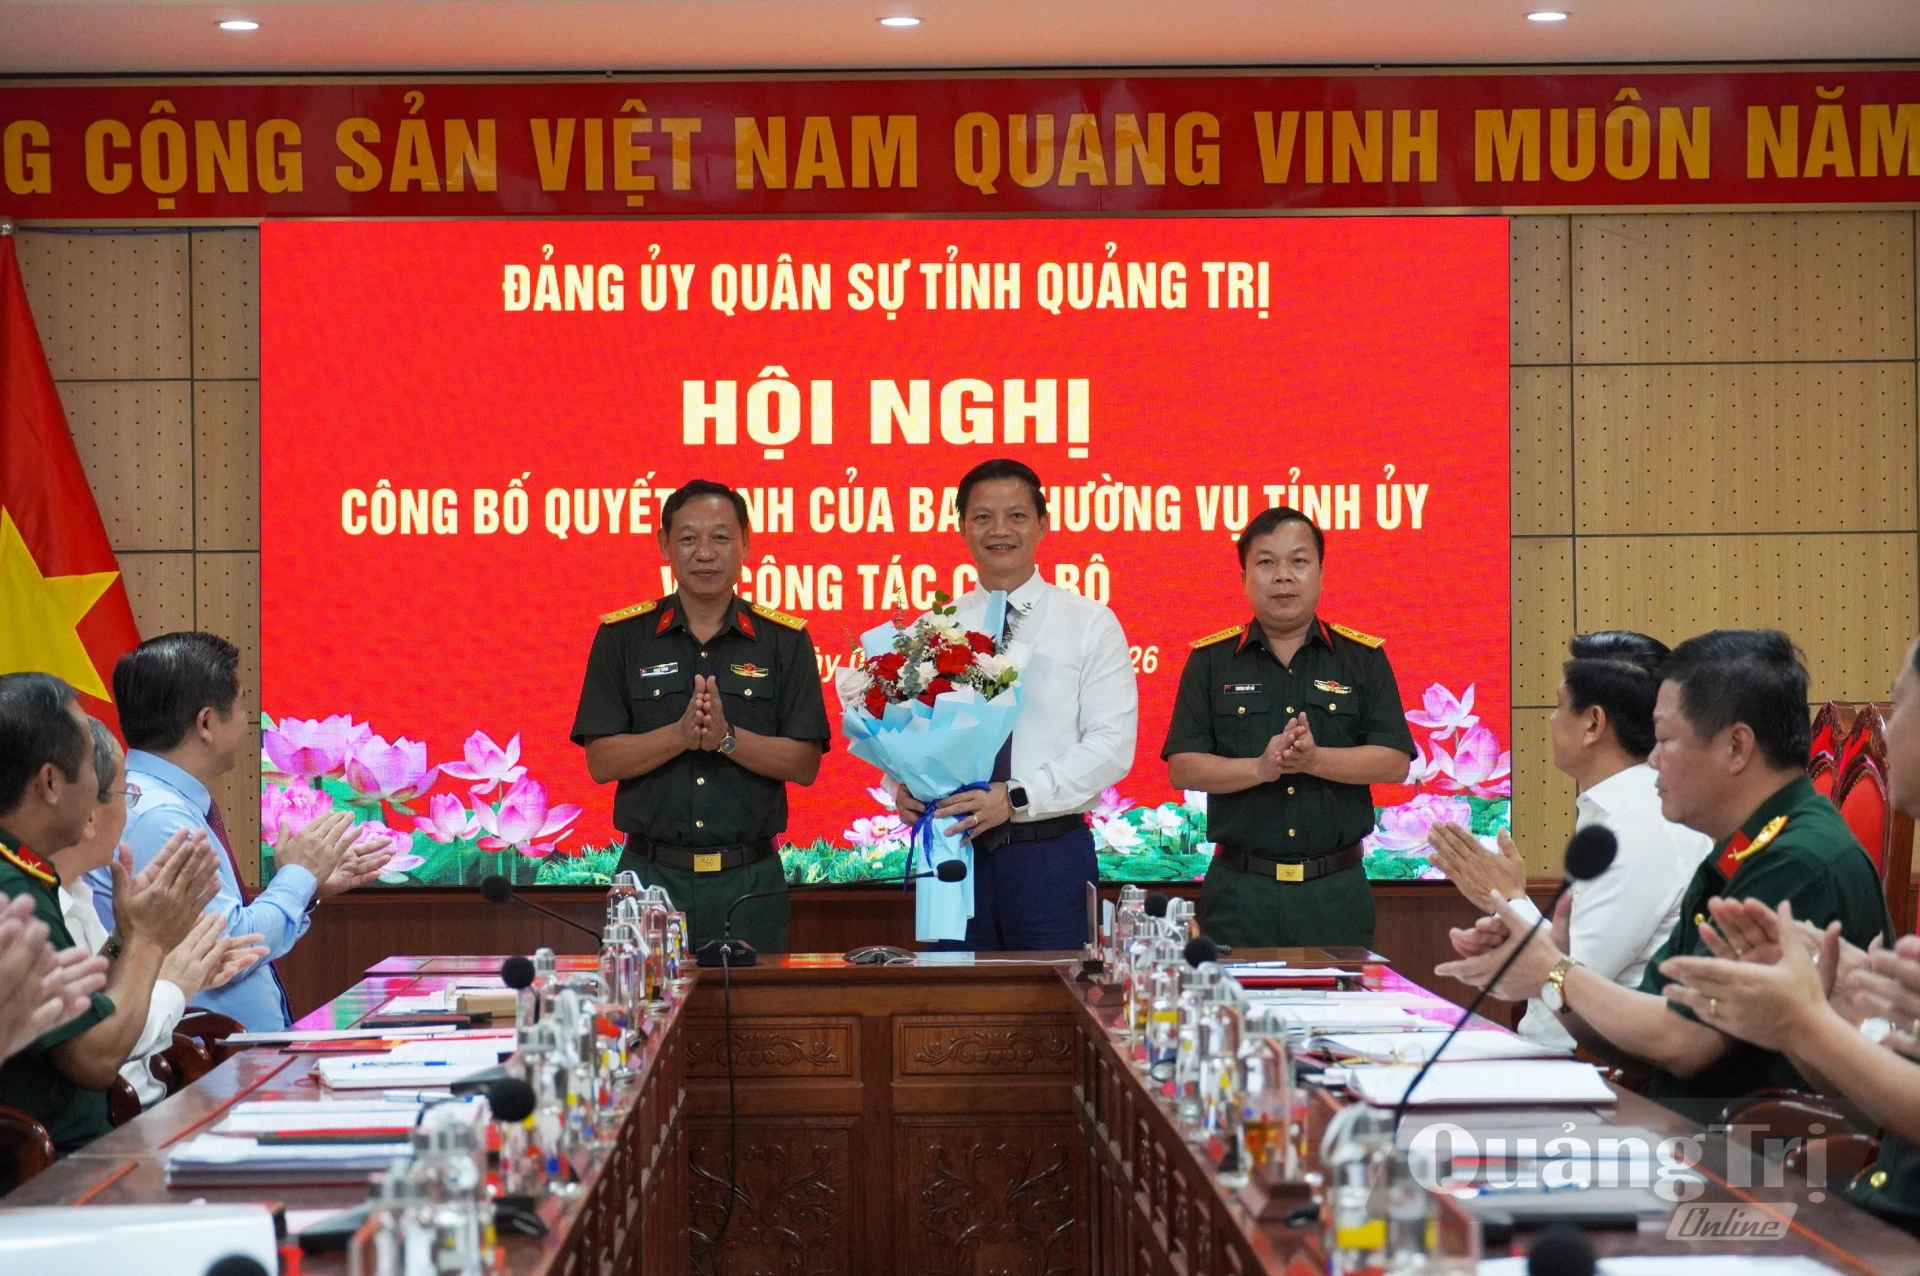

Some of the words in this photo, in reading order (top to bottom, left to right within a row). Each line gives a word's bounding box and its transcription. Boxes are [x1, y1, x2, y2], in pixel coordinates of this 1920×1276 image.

[85, 99, 303, 210] CỘNG
[334, 90, 498, 193] SẢN
[529, 98, 701, 208] VIỆT
[735, 114, 918, 190] NAM
[954, 111, 1221, 195] QUANG
[1253, 109, 1438, 184] VINH
[1475, 87, 1711, 182] MUÔN
[1746, 85, 1920, 178] NĂM
[502, 243, 625, 312] ĐẢNG
[641, 243, 696, 312] ỦY
[711, 253, 831, 317] QUÂN
[847, 258, 911, 320] SỰ
[919, 244, 1021, 310] TỈNH
[1037, 241, 1187, 316] QUẢNG
[1201, 261, 1270, 319] TRỊ
[682, 365, 834, 460] HỘI
[870, 377, 1091, 459] NGHỊ
[341, 479, 458, 536] CÔNG
[473, 471, 531, 535] BỐ
[809, 466, 895, 534] CỦA
[909, 486, 960, 533] BA
[1039, 472, 1181, 533] HƯỜNG
[1195, 484, 1249, 542] VỤ
[1263, 466, 1360, 531] TỈNH
[1376, 463, 1430, 531] ỦY
[857, 554, 937, 611] TÁC
